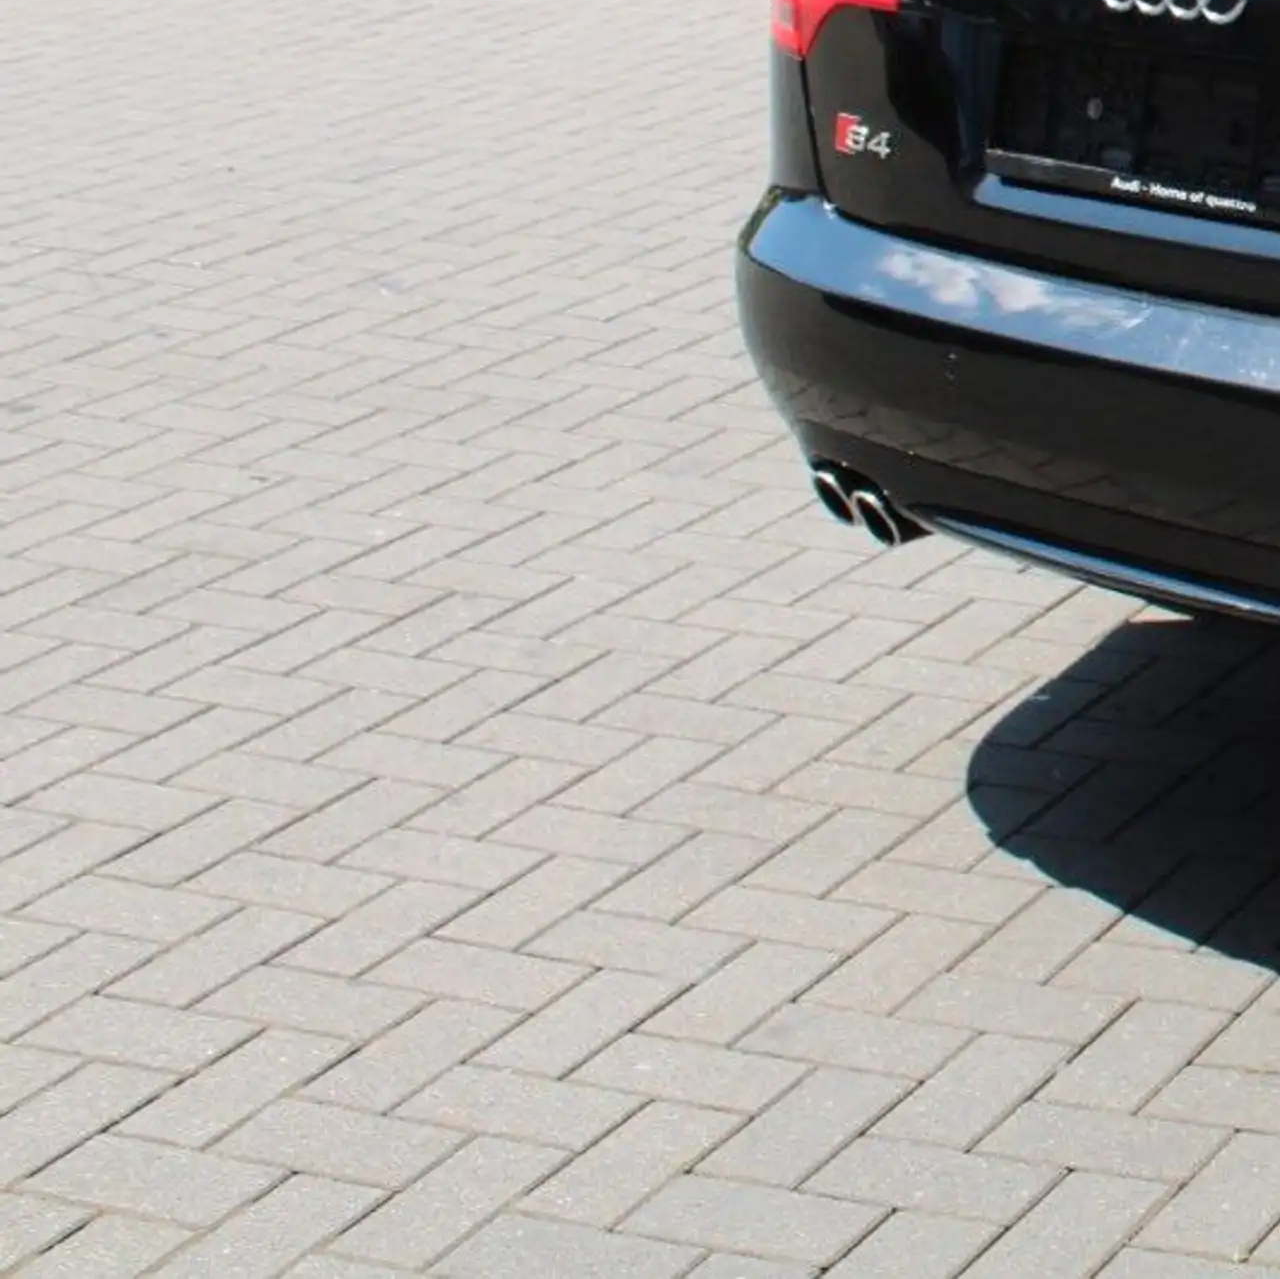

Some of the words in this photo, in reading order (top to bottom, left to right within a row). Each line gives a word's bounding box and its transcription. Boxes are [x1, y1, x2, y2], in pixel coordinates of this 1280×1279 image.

[844, 123, 891, 160] S4
[1110, 176, 1141, 193] Audi
[1150, 182, 1188, 201] Home
[1189, 191, 1205, 203] of
[1206, 194, 1257, 213] quattro
